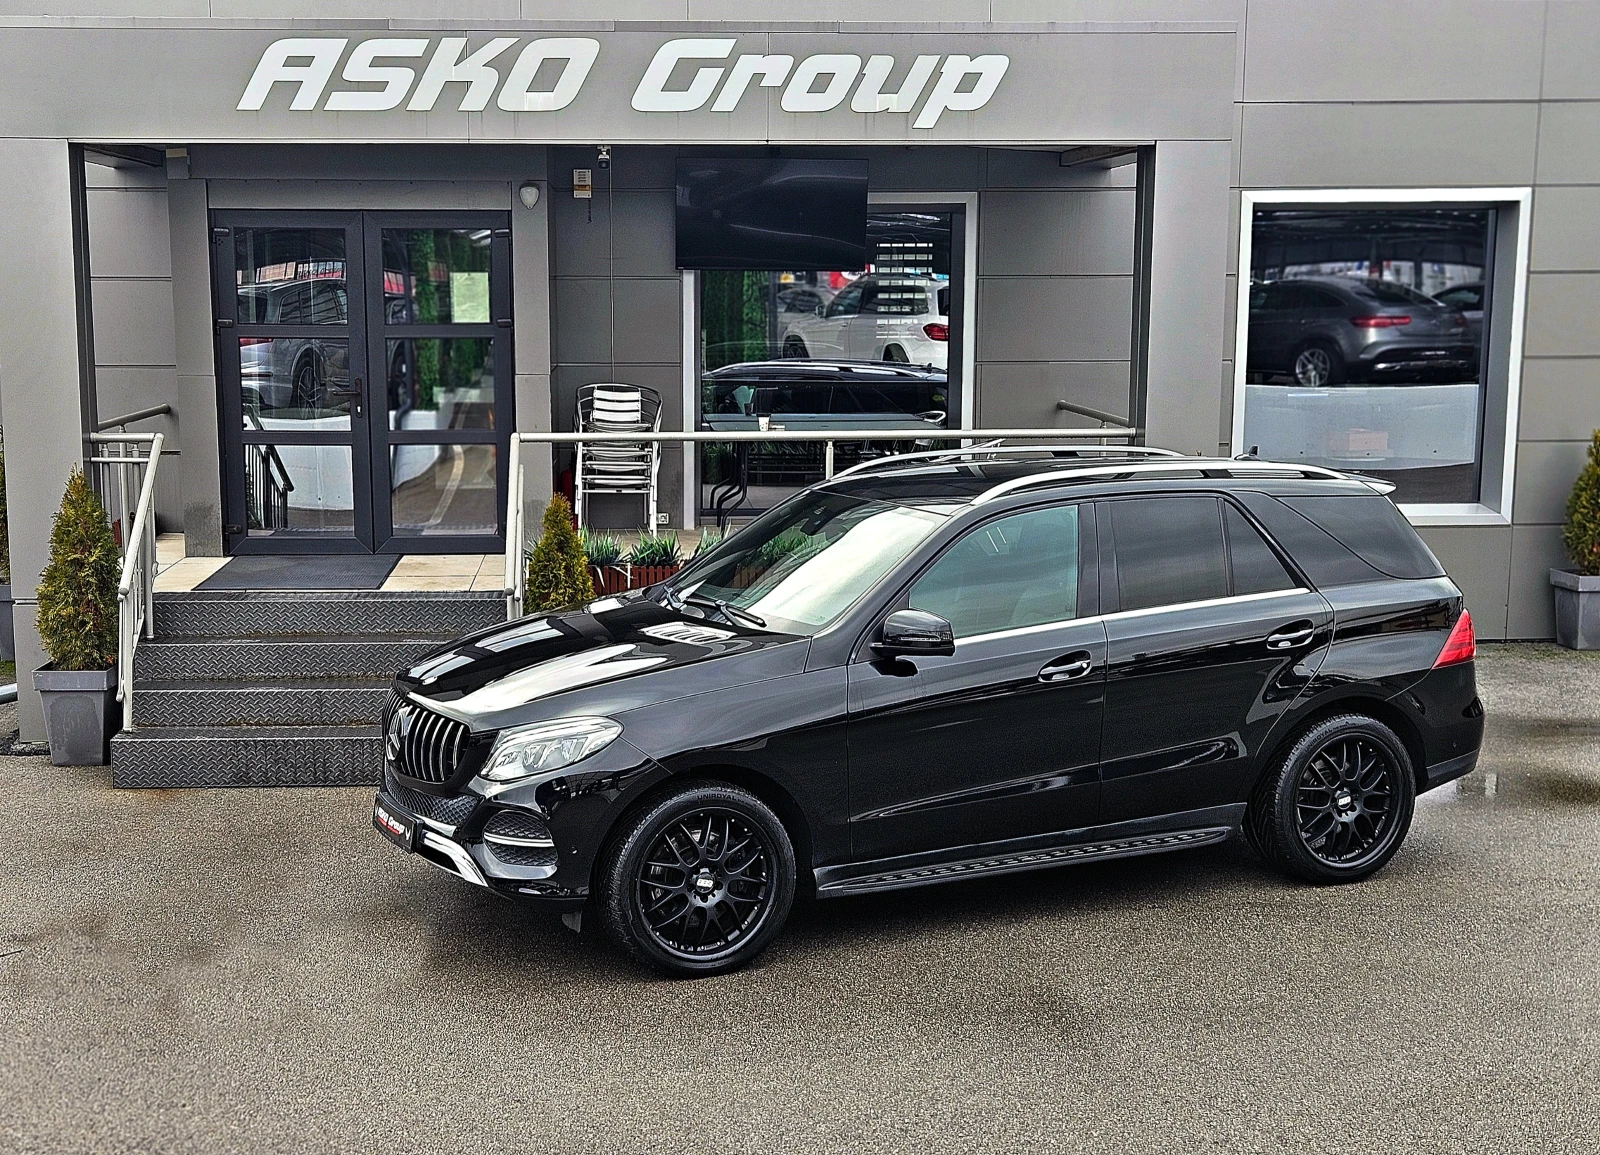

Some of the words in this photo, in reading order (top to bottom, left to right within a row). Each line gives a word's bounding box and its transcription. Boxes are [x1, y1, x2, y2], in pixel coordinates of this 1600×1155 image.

[236, 37, 602, 113] ASKO
[630, 37, 1011, 130] Group
[1305, 728, 1333, 751] UNIROYAL
[697, 793, 737, 801] UNIROYAL
